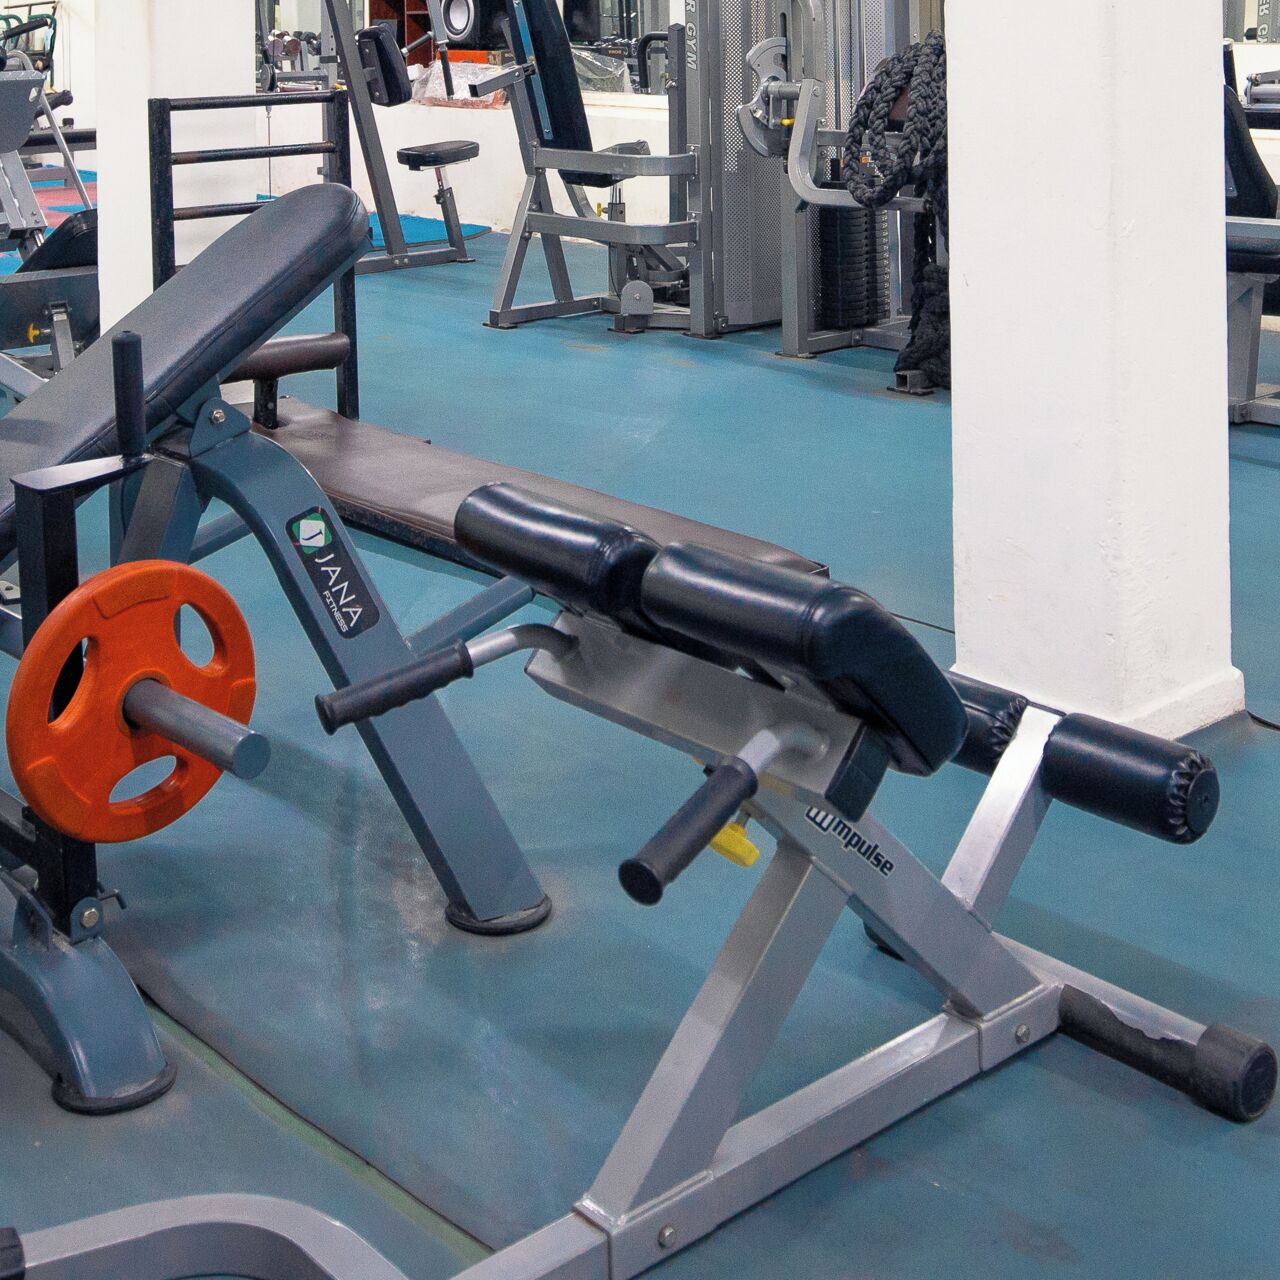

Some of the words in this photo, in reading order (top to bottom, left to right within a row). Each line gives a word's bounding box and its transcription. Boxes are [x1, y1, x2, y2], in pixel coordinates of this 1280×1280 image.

[686, 22, 697, 70] GYM
[315, 553, 363, 628] JANA
[323, 589, 349, 633] FITNESS
